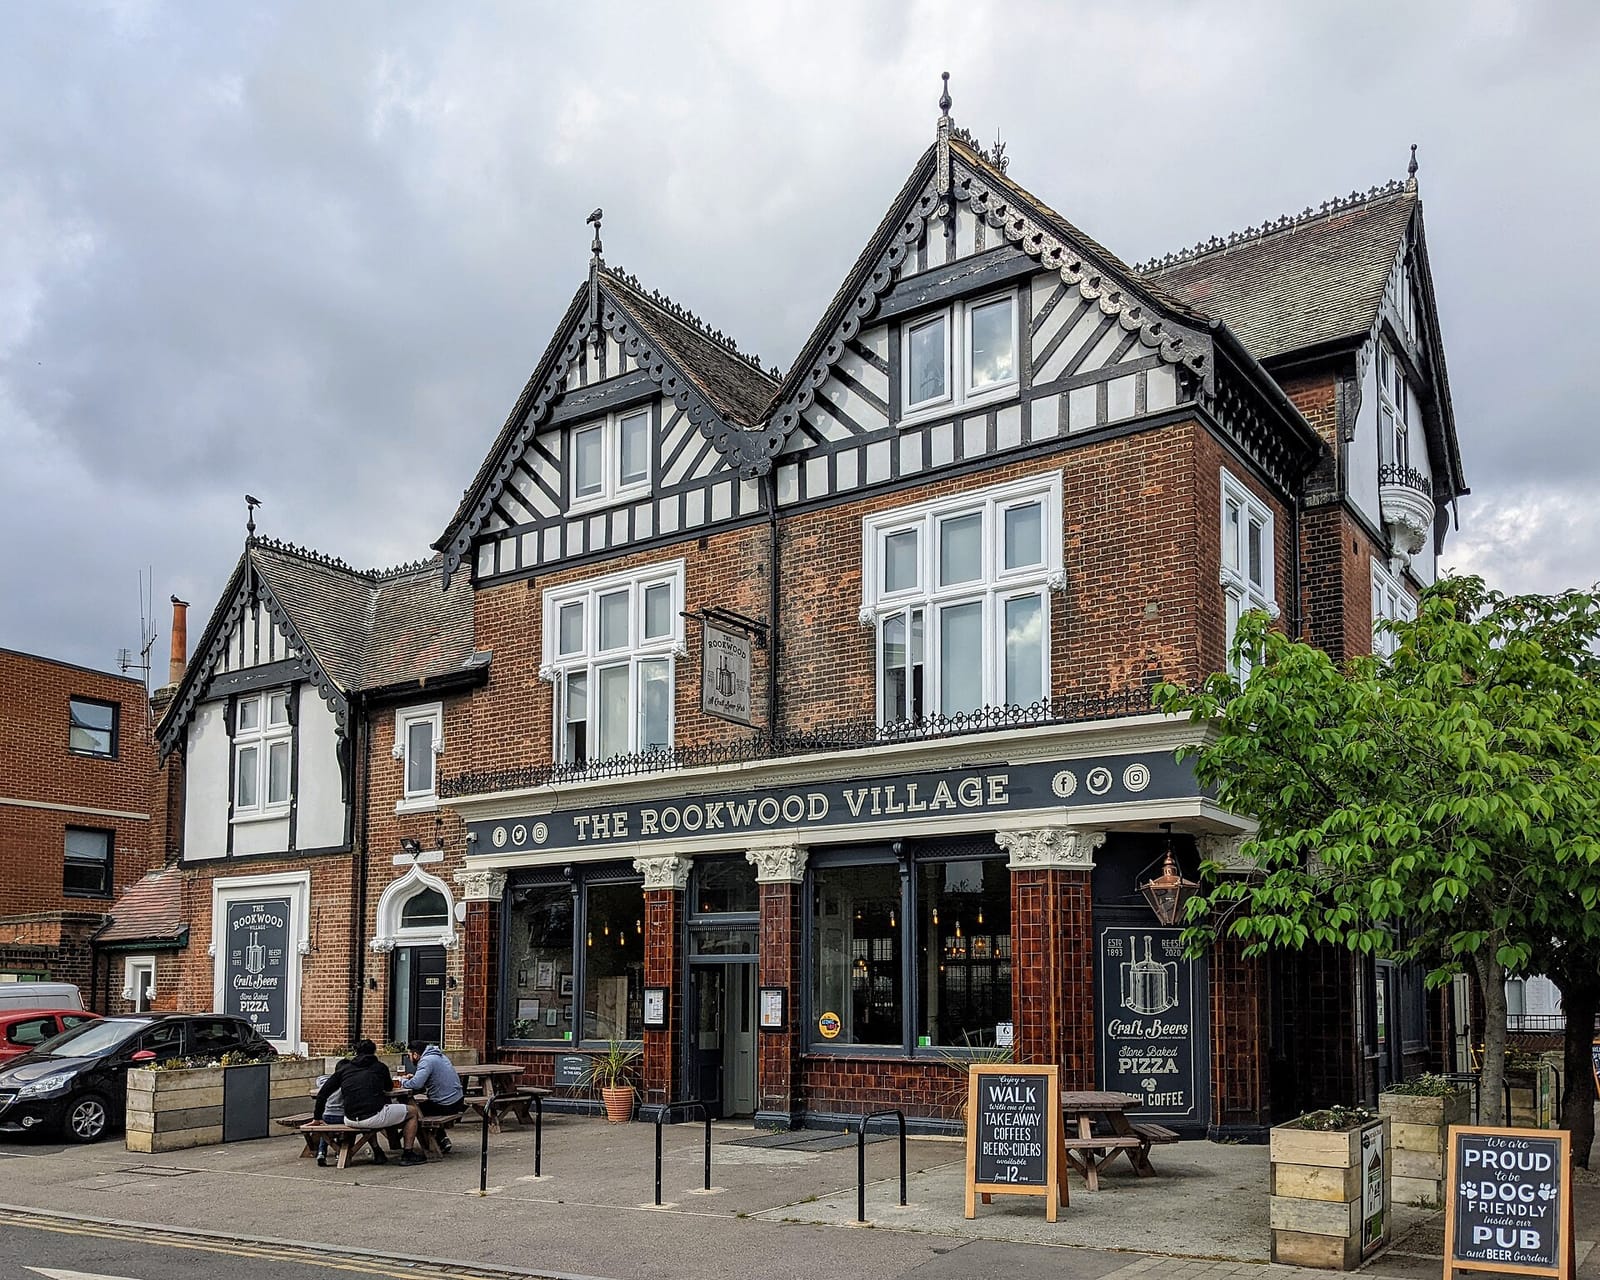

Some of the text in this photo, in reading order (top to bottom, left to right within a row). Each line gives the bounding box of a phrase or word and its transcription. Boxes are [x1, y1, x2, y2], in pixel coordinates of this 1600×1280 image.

[707, 640, 747, 660] ROOKWOOD
[573, 774, 1010, 841] THE ROOKWOOD VILLAGE
[252, 904, 265, 913] THE
[232, 913, 284, 931] ROOKWOOD
[1107, 948, 1123, 957] 1893
[1165, 949, 1182, 957] 2020
[233, 973, 278, 990] Craft Beers
[239, 991, 270, 1001] Stone Baked
[239, 1000, 270, 1012] PIZZA
[1107, 1018, 1189, 1040] Craft Beers
[1118, 1045, 1178, 1057] Stone Baked
[1118, 1057, 1179, 1074] PIZZA
[999, 1075, 1020, 1086] Enjoy
[989, 1086, 1037, 1103] WALK
[1148, 1091, 1184, 1106] COFFEE
[1017, 1103, 1026, 1114] of
[983, 1112, 1042, 1127] TAKEAWAY
[993, 1126, 1031, 1141] COFFEES
[1486, 1137, 1530, 1149] We are
[996, 1157, 1027, 1166] available
[1464, 1149, 1552, 1172] PROUD
[992, 1172, 1007, 1183] from
[1006, 1165, 1019, 1183] 12
[1508, 1172, 1521, 1182] be
[1480, 1181, 1535, 1203] DOG
[1468, 1201, 1547, 1218] FRIENDLY
[1515, 1219, 1532, 1227] our
[1473, 1226, 1541, 1250] PUB
[1466, 1248, 1549, 1263] and BEER Garden
